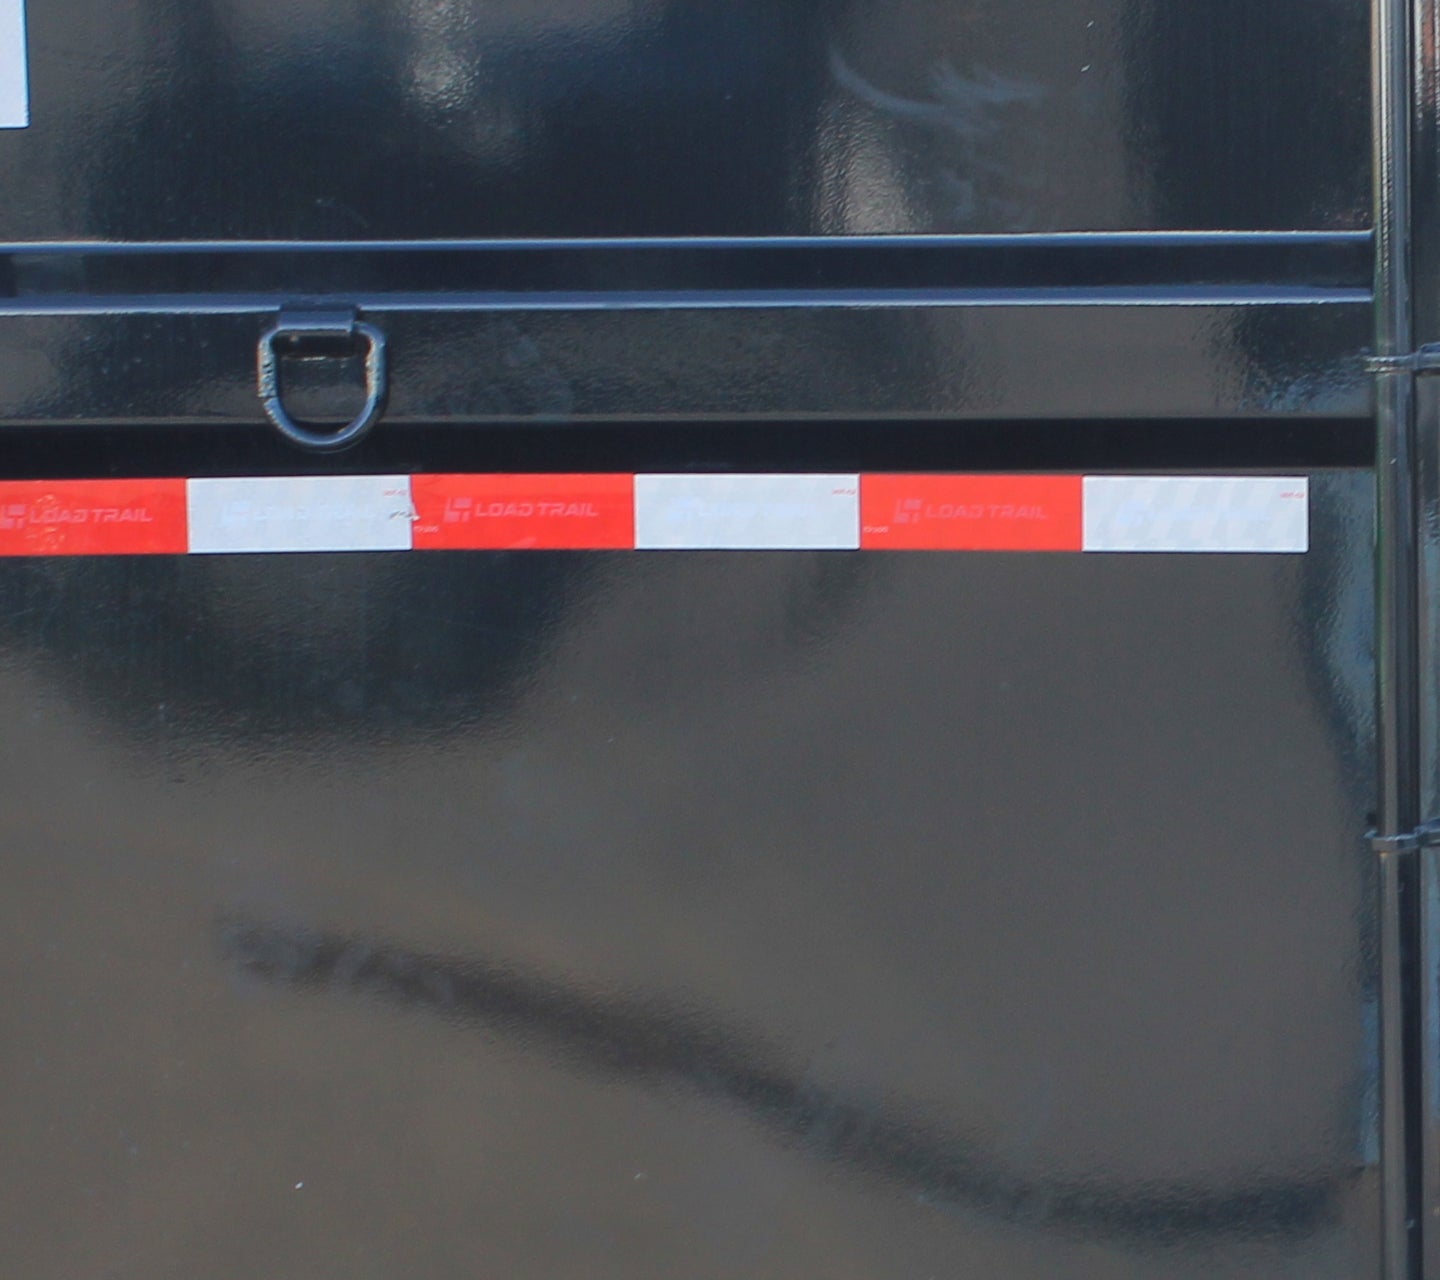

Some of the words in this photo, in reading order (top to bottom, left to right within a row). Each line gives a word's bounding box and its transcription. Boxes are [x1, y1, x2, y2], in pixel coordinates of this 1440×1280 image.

[28, 509, 89, 524] LOAD
[92, 508, 153, 523] TRAIL
[474, 503, 534, 517] LOAD
[537, 503, 600, 517] TRAIL
[924, 503, 985, 519] LOAD
[987, 504, 1048, 519] TRAIL
